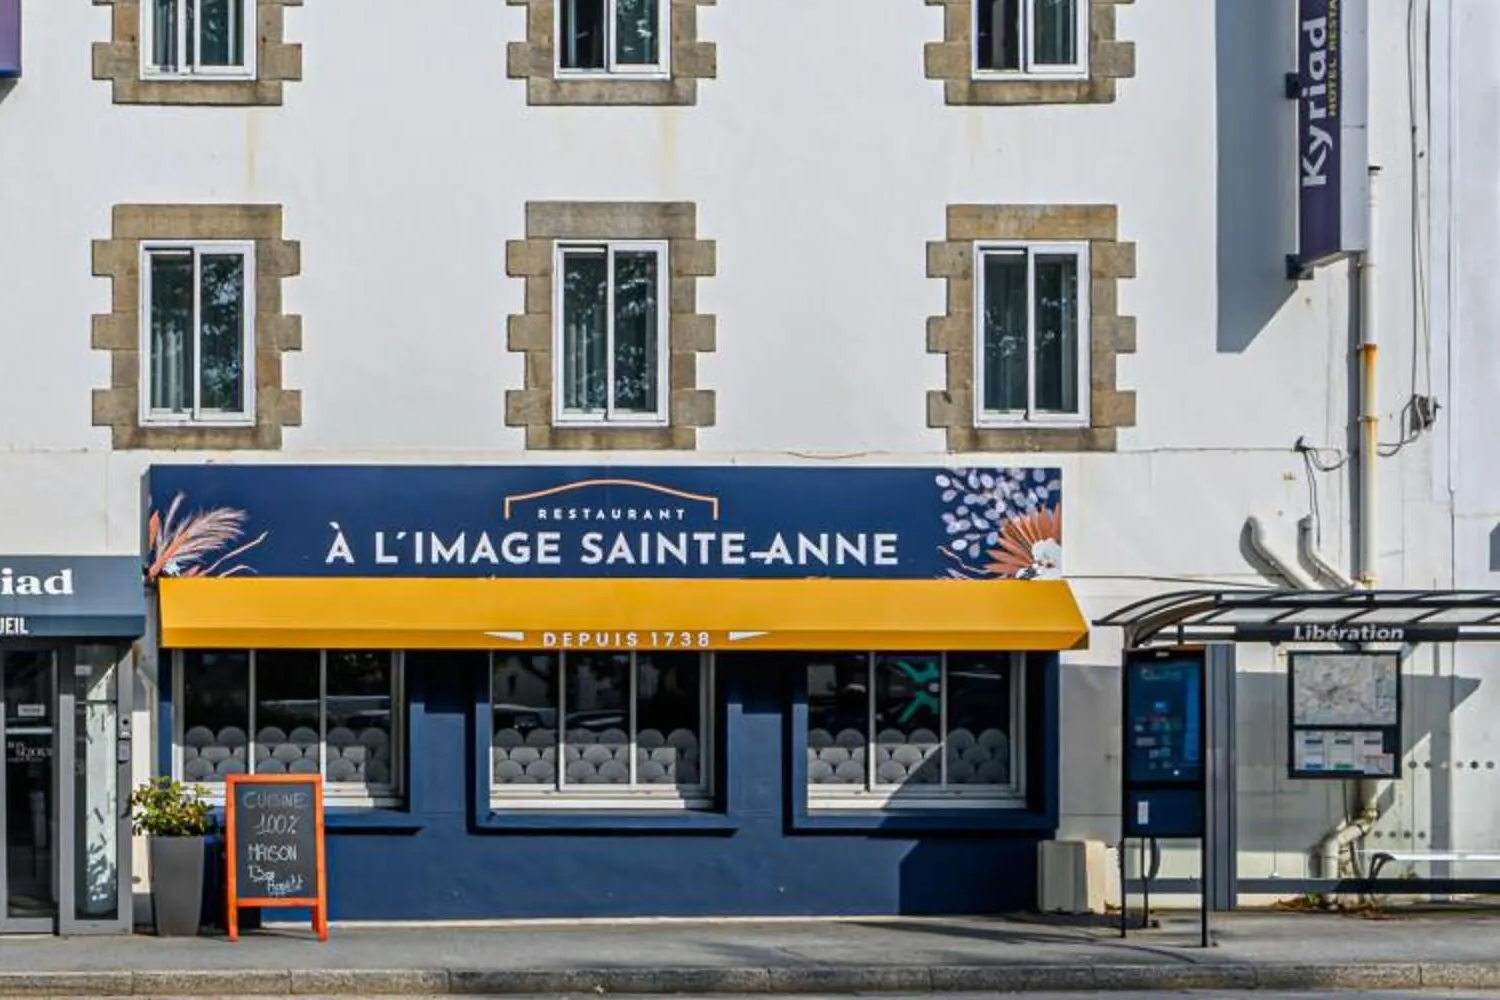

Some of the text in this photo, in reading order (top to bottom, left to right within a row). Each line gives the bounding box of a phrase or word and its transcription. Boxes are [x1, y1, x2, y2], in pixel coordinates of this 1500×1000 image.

[1327, 55, 1338, 117] HOTEL
[1302, 16, 1334, 188] Kyriad
[537, 508, 686, 520] RESTAURANT
[324, 521, 355, 564] À
[580, 531, 899, 566] SAINTE-ANNE
[542, 631, 710, 648] DEPUIS 1738
[1293, 625, 1404, 641] Libération
[242, 790, 308, 809] CUISINE
[254, 813, 301, 835] 100%
[247, 843, 297, 862] MAISON
